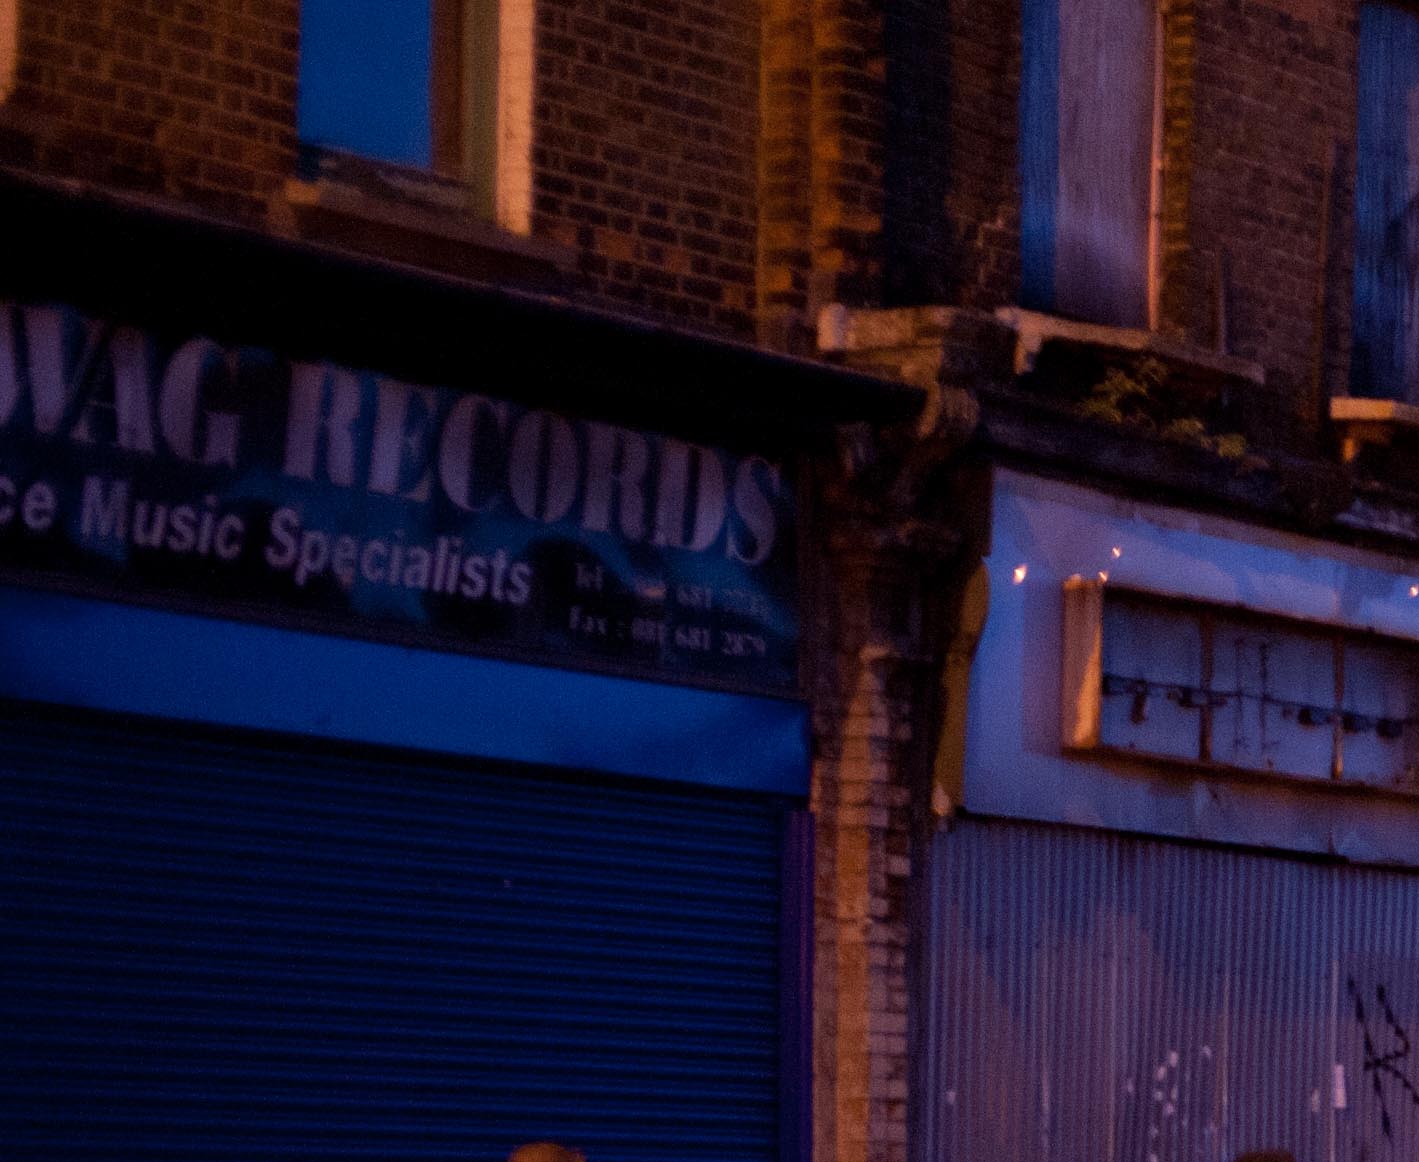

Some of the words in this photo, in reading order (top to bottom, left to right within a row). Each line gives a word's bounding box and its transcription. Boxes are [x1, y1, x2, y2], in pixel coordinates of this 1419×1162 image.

[80, 475, 246, 560] Music
[265, 506, 534, 604] Specialists
[282, 362, 783, 566] RECORDS
